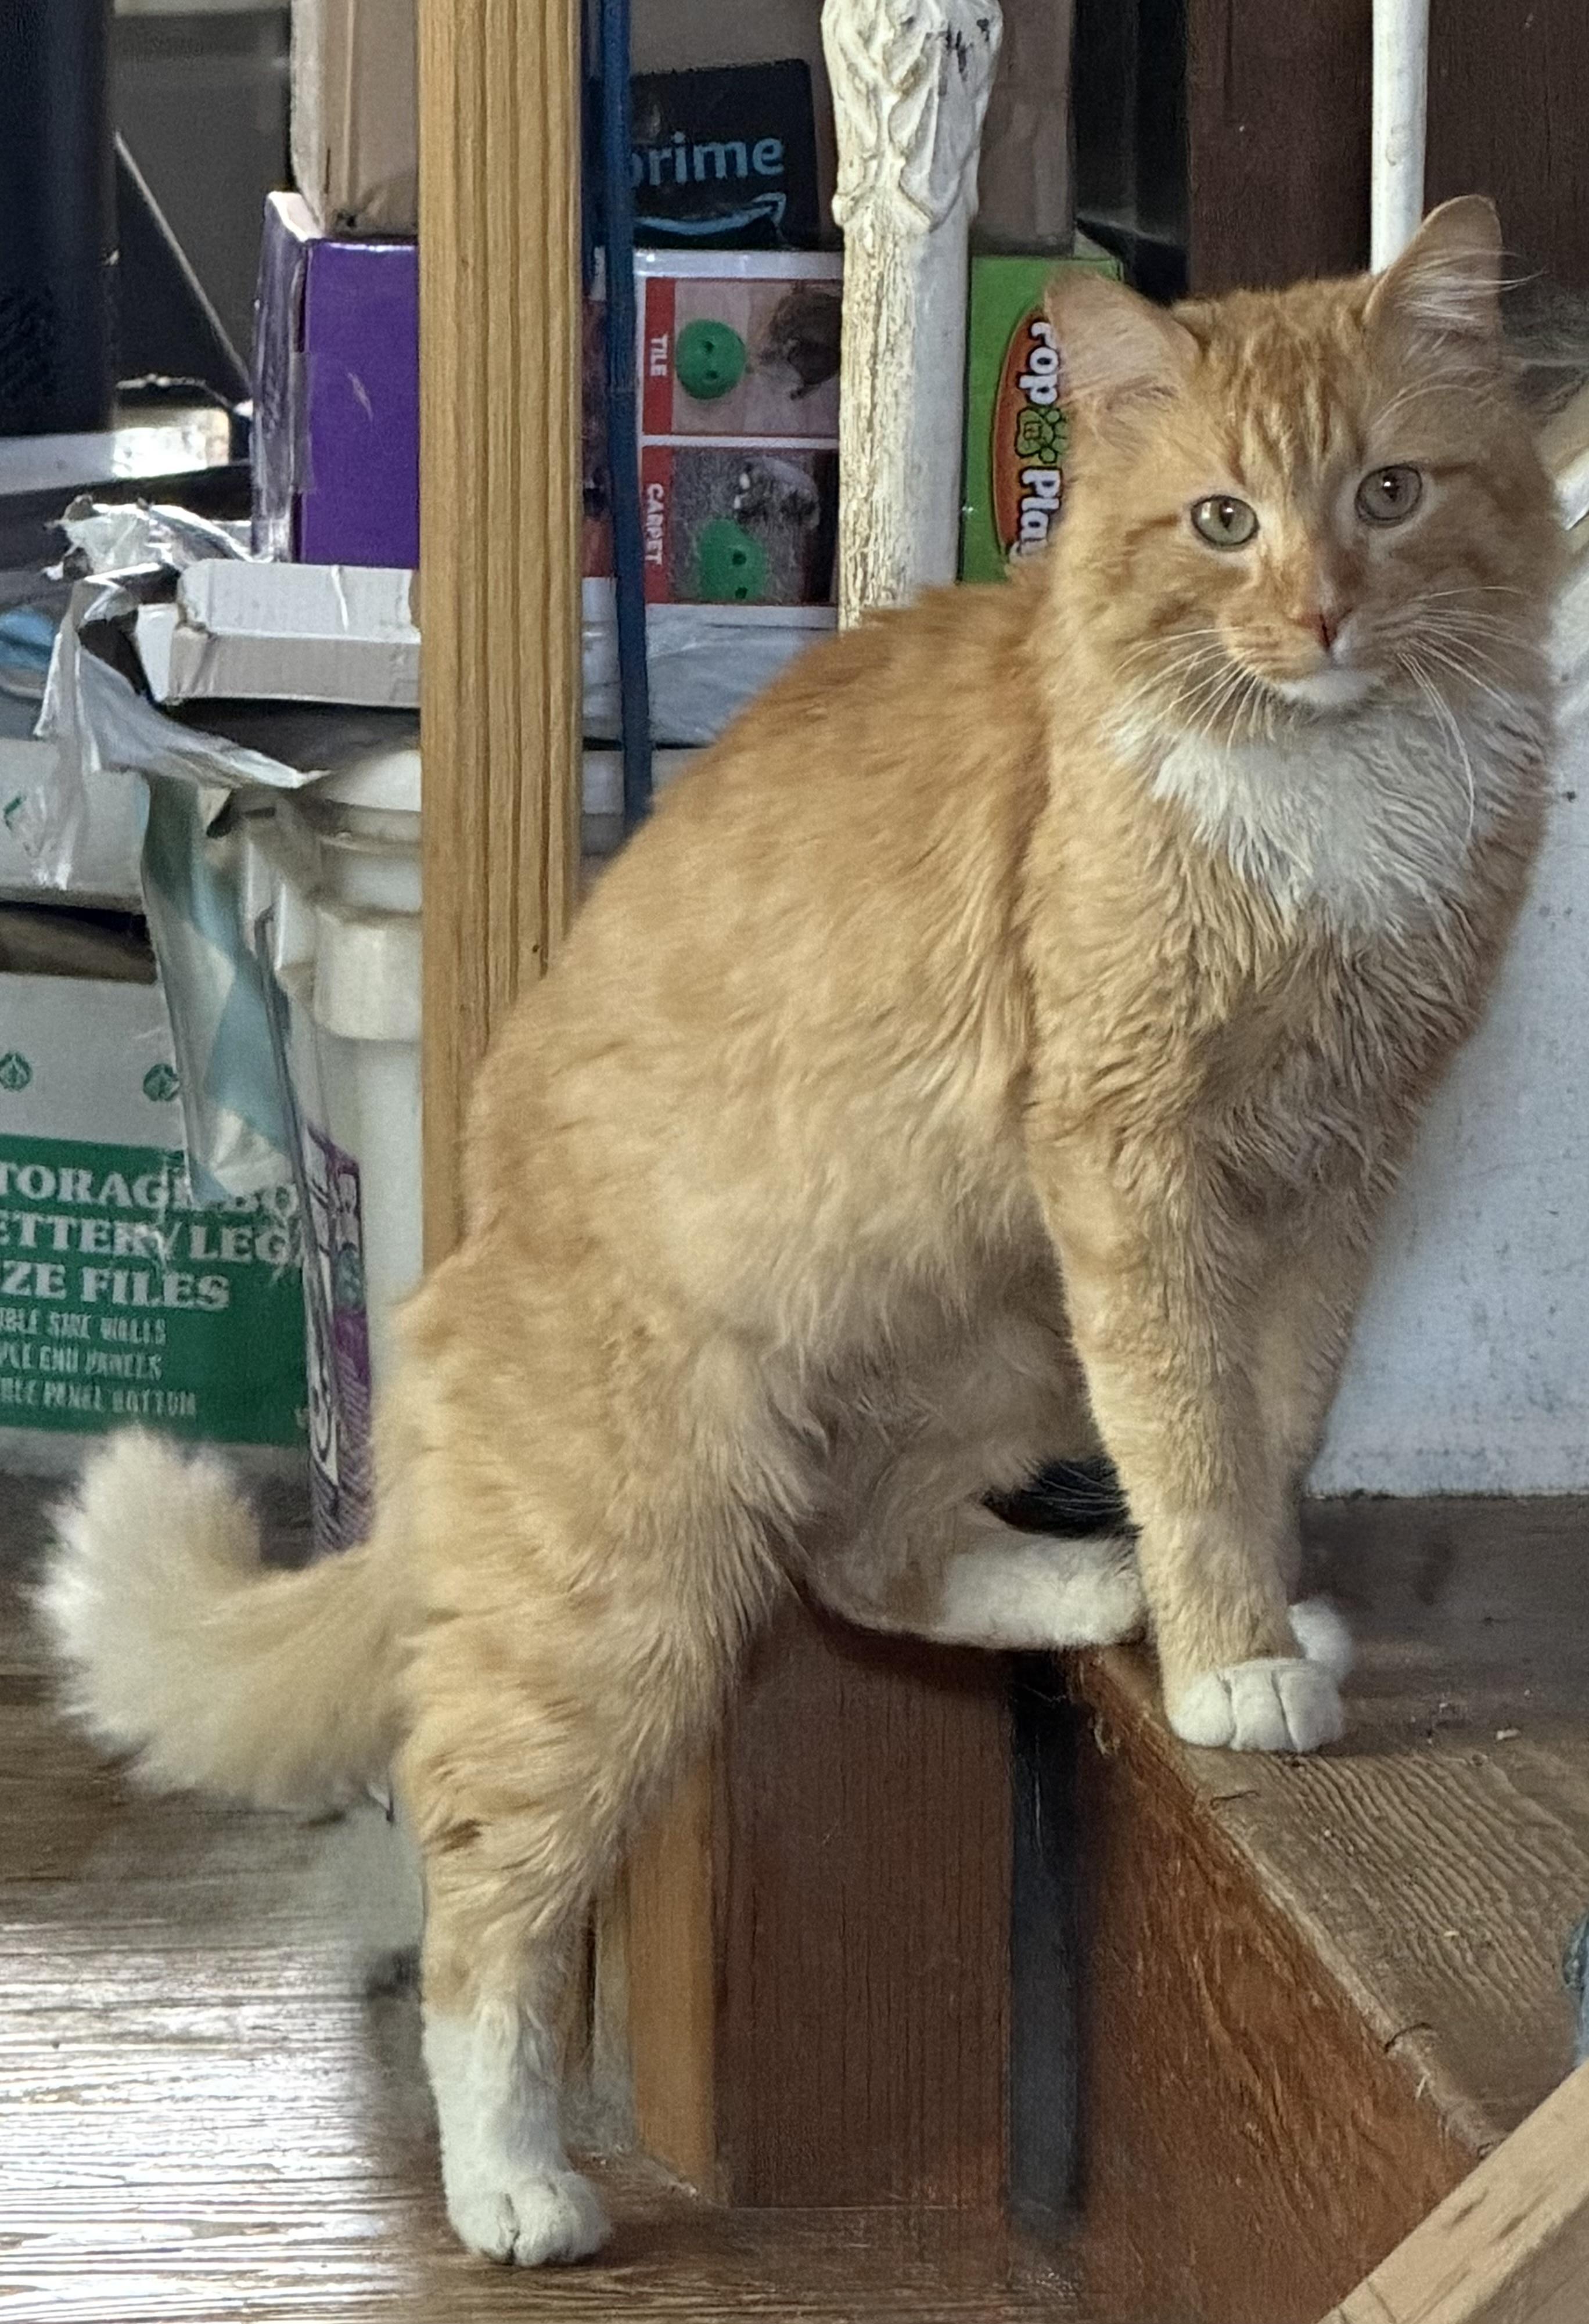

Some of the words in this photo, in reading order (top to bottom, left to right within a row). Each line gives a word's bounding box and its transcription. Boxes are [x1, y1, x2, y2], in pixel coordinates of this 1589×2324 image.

[649, 333, 669, 377] TILE
[645, 483, 666, 566] CARPET
[81, 1267, 230, 1311] FILES
